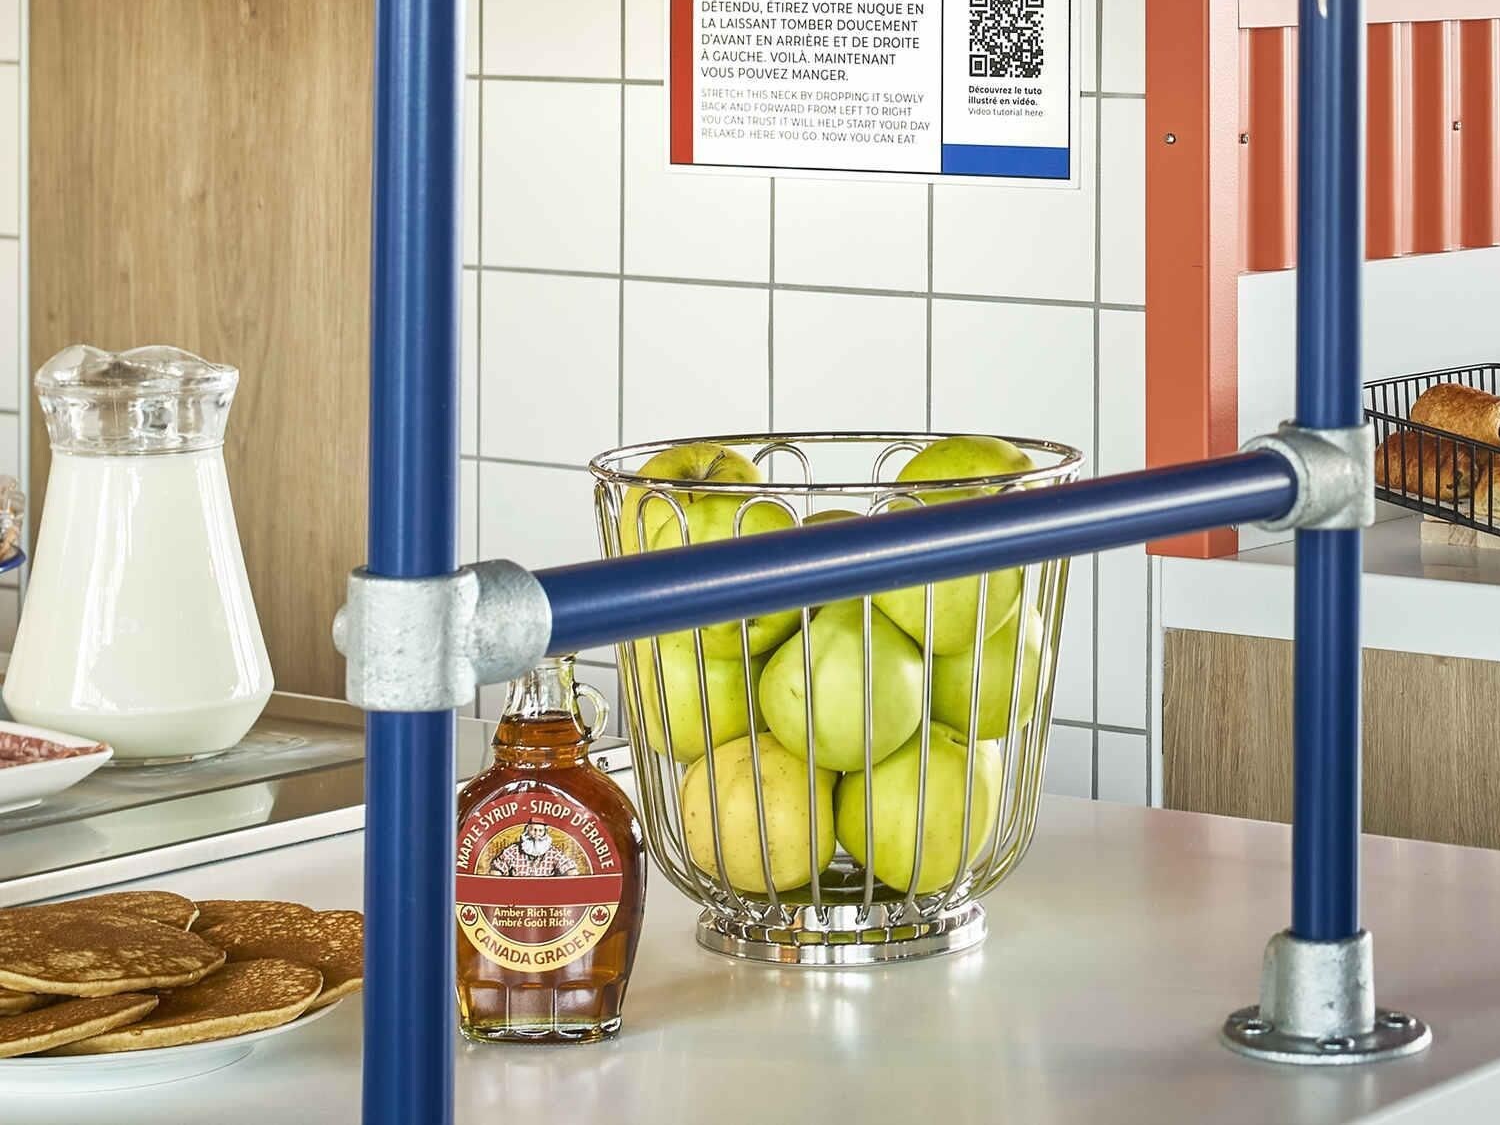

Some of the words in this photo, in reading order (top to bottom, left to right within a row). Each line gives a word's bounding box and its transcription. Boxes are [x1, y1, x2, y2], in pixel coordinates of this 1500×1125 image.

[701, 0, 763, 14] DÉTENDU,
[766, 0, 809, 14] ÉTIREZ
[812, 2, 853, 14] VOTRE
[857, 3, 903, 16] NUQUE
[907, 3, 924, 15] EN
[701, 18, 716, 29] LA
[720, 18, 776, 30] LAISSANT
[780, 18, 833, 30] TOMBER
[837, 19, 918, 32] DOUCEMENT
[701, 34, 752, 46] D'AVANT
[756, 35, 772, 46] EN
[776, 33, 829, 47] ARRIÈRE
[834, 36, 848, 47] ET
[852, 36, 869, 48] DE
[873, 37, 920, 49] DROITE
[701, 48, 709, 61] À
[713, 51, 766, 63] GAUCHE.
[770, 49, 810, 64] VOILÀ.
[814, 53, 896, 65] MAINTENANT
[701, 67, 734, 79] VOUS
[738, 68, 788, 80] POUVEZ
[792, 69, 849, 81] MANGER.
[701, 88, 744, 98] STRETCH
[747, 89, 768, 99] THIS
[771, 90, 798, 100] NECK
[800, 90, 813, 100] BY
[816, 91, 869, 102] DROPPING
[872, 92, 880, 102] IT
[883, 92, 924, 103] SLOWLY
[969, 86, 1012, 94] Découvrez
[968, 96, 997, 104] illustré
[1012, 97, 1038, 106] vidéo.
[701, 102, 727, 111] BACK
[729, 102, 752, 112] AND
[754, 103, 804, 114] FORWARD
[807, 105, 837, 115] FROM
[840, 106, 862, 115] LEFT
[866, 106, 879, 116] TO
[882, 107, 912, 117] RIGHT
[993, 108, 1022, 116] tutorial
[701, 115, 721, 125] YOU
[723, 116, 744, 125] CAN
[747, 116, 776, 126] TRUST
[780, 117, 788, 127] IT
[790, 118, 815, 128] WILL
[818, 118, 844, 129] HELP
[846, 119, 876, 130] START
[879, 120, 907, 130] YOUR
[749, 130, 776, 140] HERE
[778, 131, 799, 140] YOU
[822, 132, 847, 142] NOW
[850, 133, 871, 143] YOU
[873, 134, 894, 144] CAN
[456, 827, 482, 869] MAPLE
[478, 802, 519, 832] SYRUP
[530, 800, 572, 820] SIROP
[570, 813, 615, 869] D'ÉRABLE
[494, 908, 525, 918] Amber
[527, 907, 547, 917] Rich
[550, 908, 572, 917] Taste
[491, 918, 522, 927] Ambré
[524, 917, 547, 927] Goût
[549, 918, 575, 926] Riche
[474, 927, 532, 965] CANADA
[534, 939, 586, 965] GRADE
[582, 928, 596, 943] A
